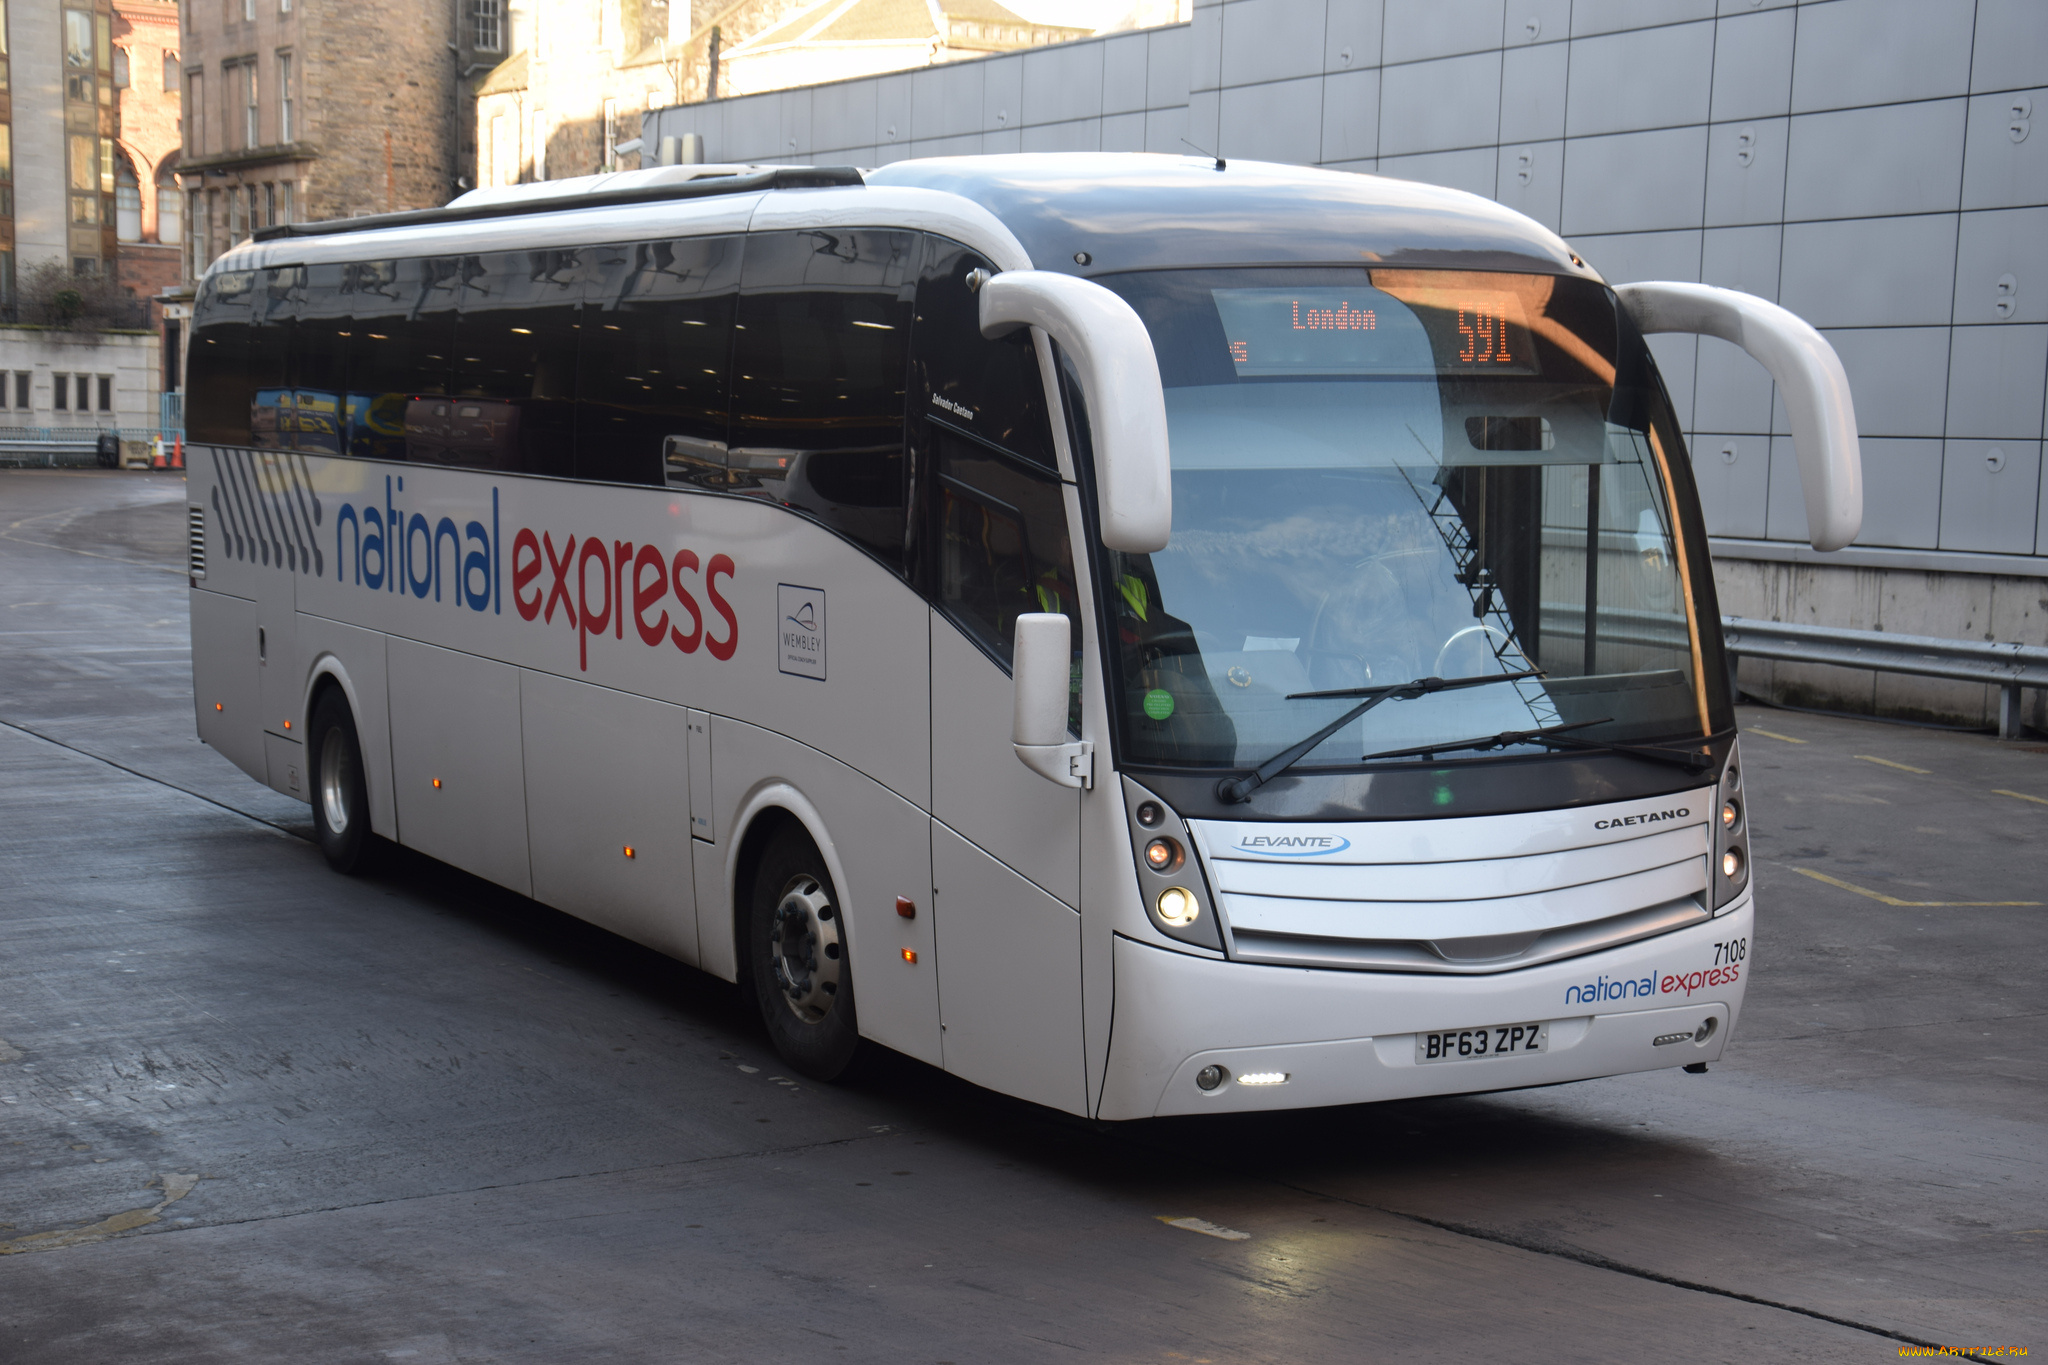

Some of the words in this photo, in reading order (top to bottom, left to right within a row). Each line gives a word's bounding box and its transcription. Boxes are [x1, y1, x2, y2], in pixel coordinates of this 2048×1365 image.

[1293, 301, 1376, 330] London
[1458, 302, 1511, 362] 591
[932, 392, 953, 411] Salvador
[953, 402, 974, 420] Caetano
[337, 475, 500, 615] national
[512, 527, 739, 672] express
[783, 632, 821, 652] WEMBLEY
[1594, 808, 1690, 829] CAETANO
[1241, 836, 1333, 848] LEVANTE
[1714, 937, 1746, 966] 7108
[1565, 970, 1657, 1004] national
[1661, 964, 1740, 997] express
[1426, 1030, 1489, 1059] BF63
[1495, 1025, 1540, 1053] ZPZ
